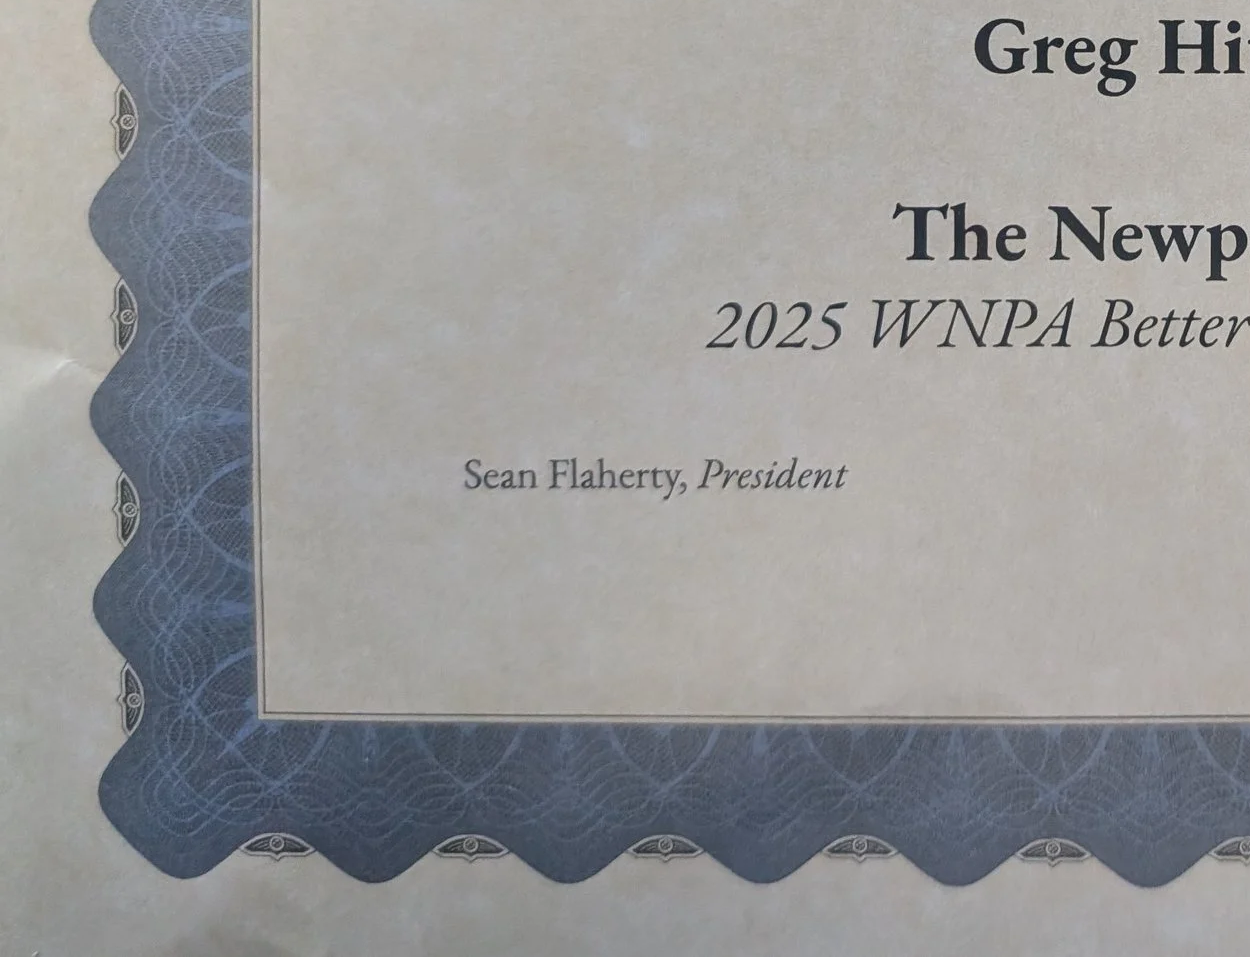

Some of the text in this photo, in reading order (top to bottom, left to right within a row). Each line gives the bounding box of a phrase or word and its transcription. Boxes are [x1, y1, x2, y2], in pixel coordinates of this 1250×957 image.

[974, 18, 1138, 97] Greg
[892, 202, 1026, 261] The
[705, 302, 848, 351] 2025
[872, 298, 1074, 348] WNPA
[465, 457, 848, 500] Sean Flaherty, President
